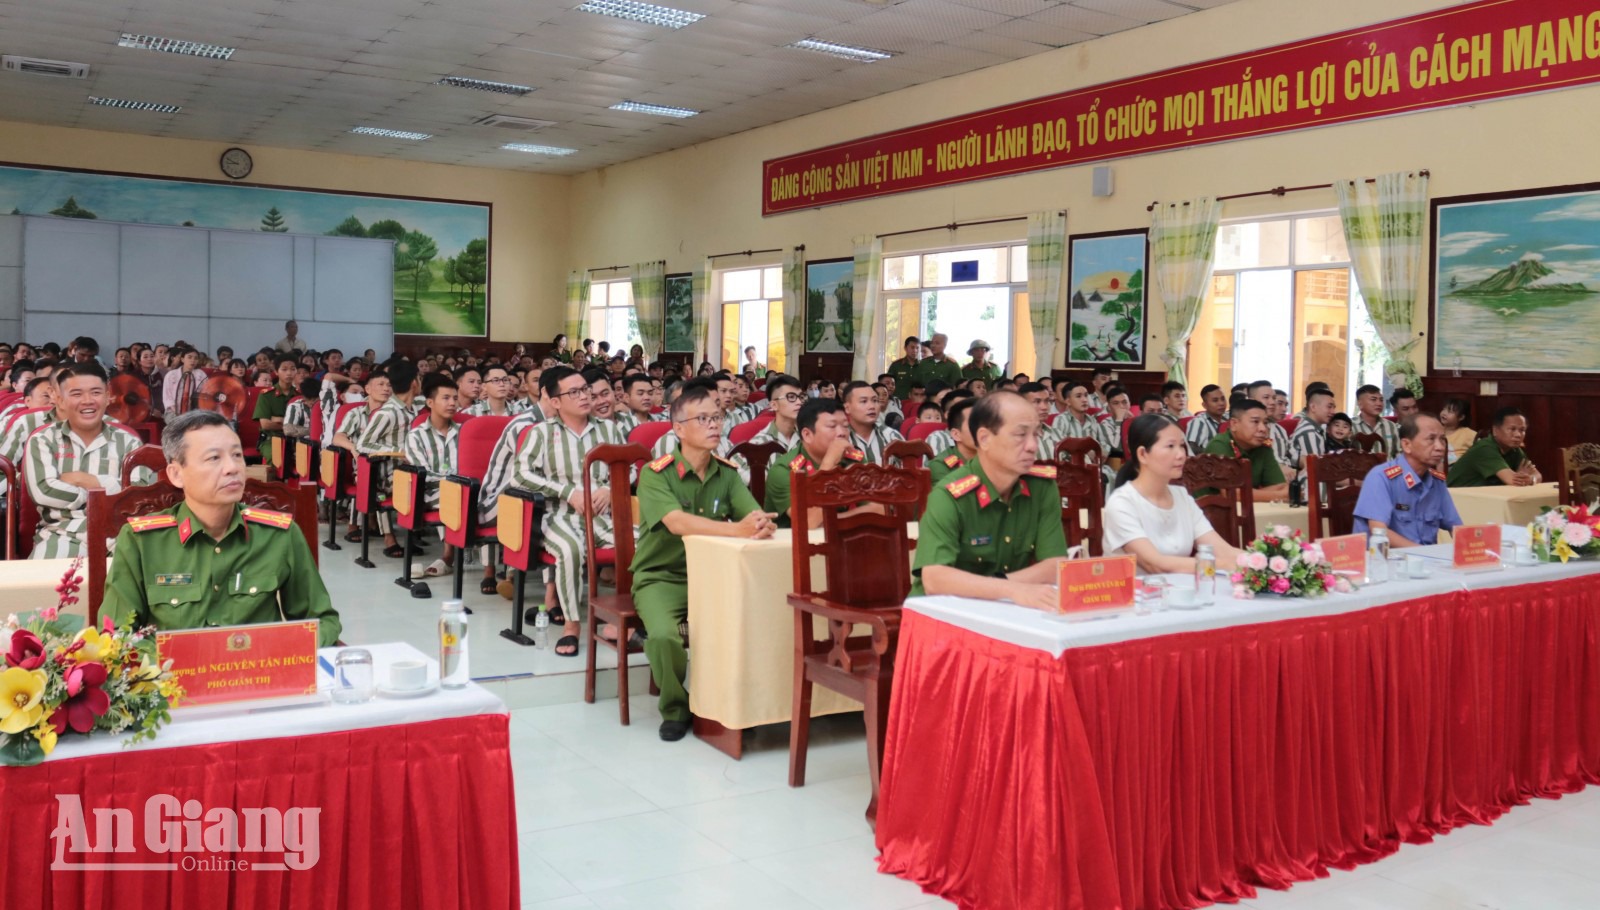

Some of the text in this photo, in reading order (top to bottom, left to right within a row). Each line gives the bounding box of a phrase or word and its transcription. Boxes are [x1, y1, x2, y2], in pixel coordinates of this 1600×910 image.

[771, 167, 800, 202] ĐẢNG
[802, 164, 832, 200] CỘNG
[835, 153, 860, 190] SẢN
[863, 150, 889, 189] VIỆT
[892, 147, 923, 180] NAM
[936, 129, 981, 173] NGƯỜI
[986, 124, 1028, 163] LÃNH
[1032, 117, 1070, 160] ĐẠO,
[1077, 97, 1099, 146] TỔ
[1104, 95, 1157, 142] CHỨC
[1163, 89, 1205, 136] MỌI
[1212, 66, 1289, 124] THẮNG
[1296, 61, 1336, 115] LỢI
[1344, 41, 1400, 101] CỦA
[1409, 32, 1492, 90] CÁCH
[1502, 10, 1600, 78] MẠNG
